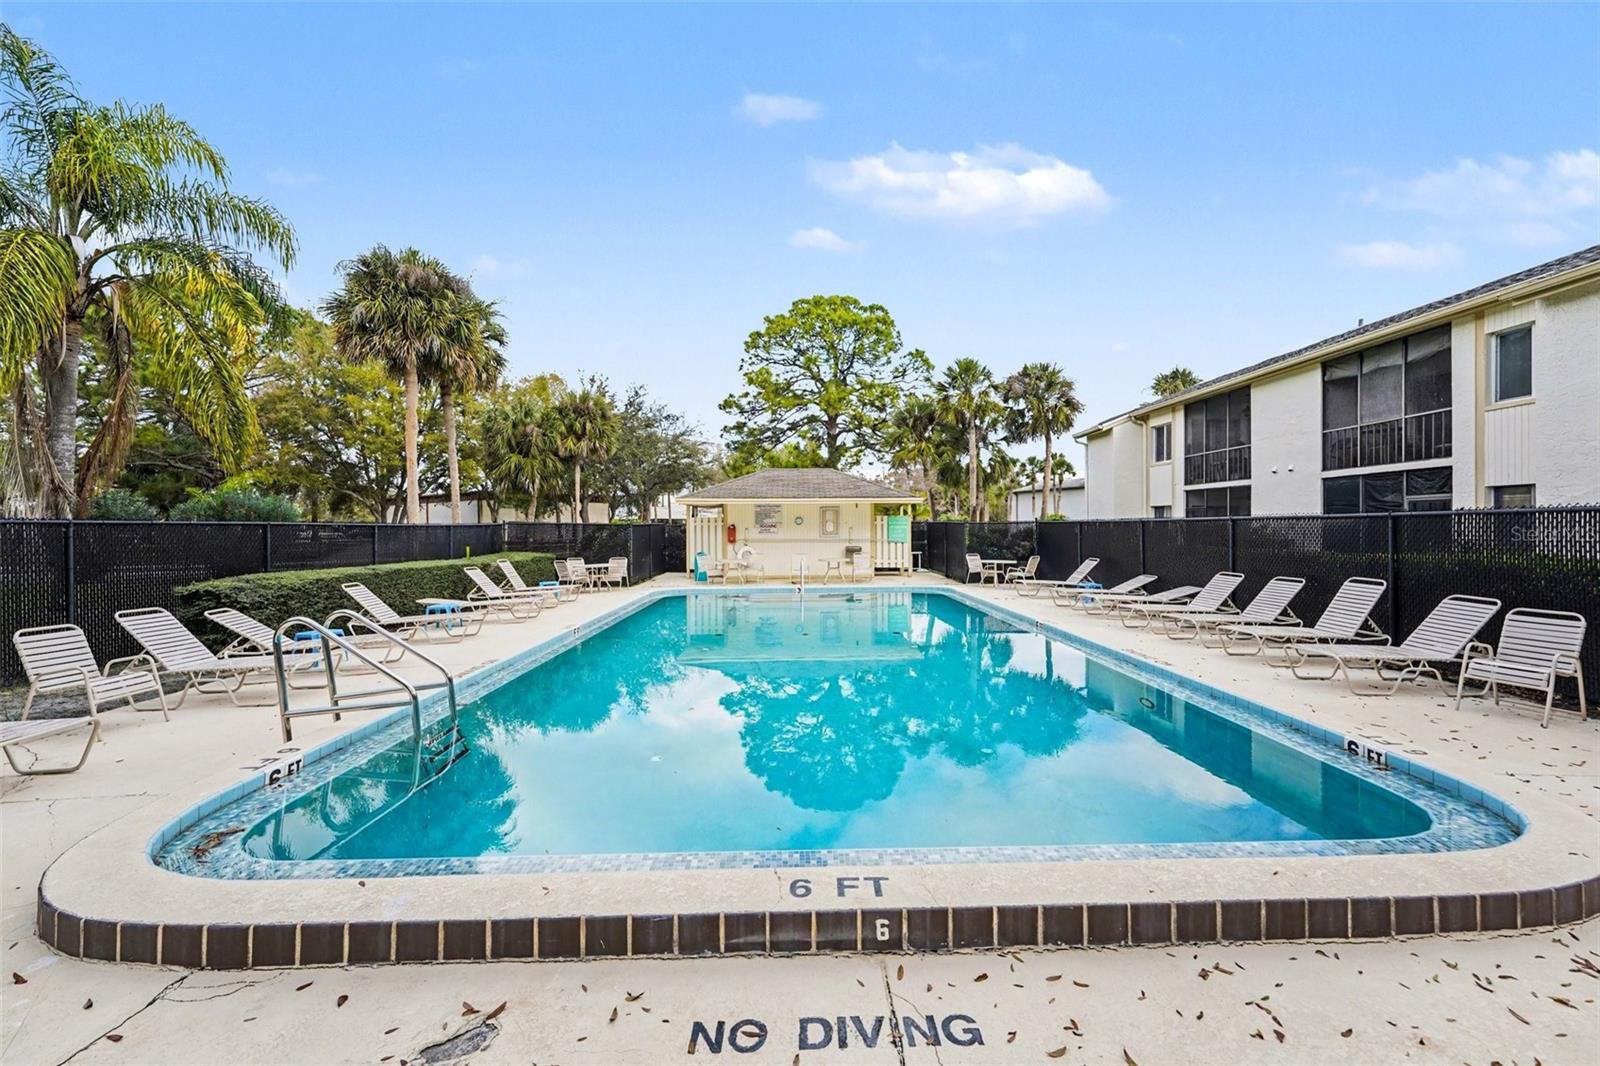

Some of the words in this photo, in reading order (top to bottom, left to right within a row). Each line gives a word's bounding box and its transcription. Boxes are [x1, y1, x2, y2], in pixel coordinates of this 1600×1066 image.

[287, 759, 302, 776] FT
[789, 878, 812, 898] 6
[836, 876, 889, 898] FT
[875, 918, 890, 942] 6
[687, 1018, 769, 1056] NO
